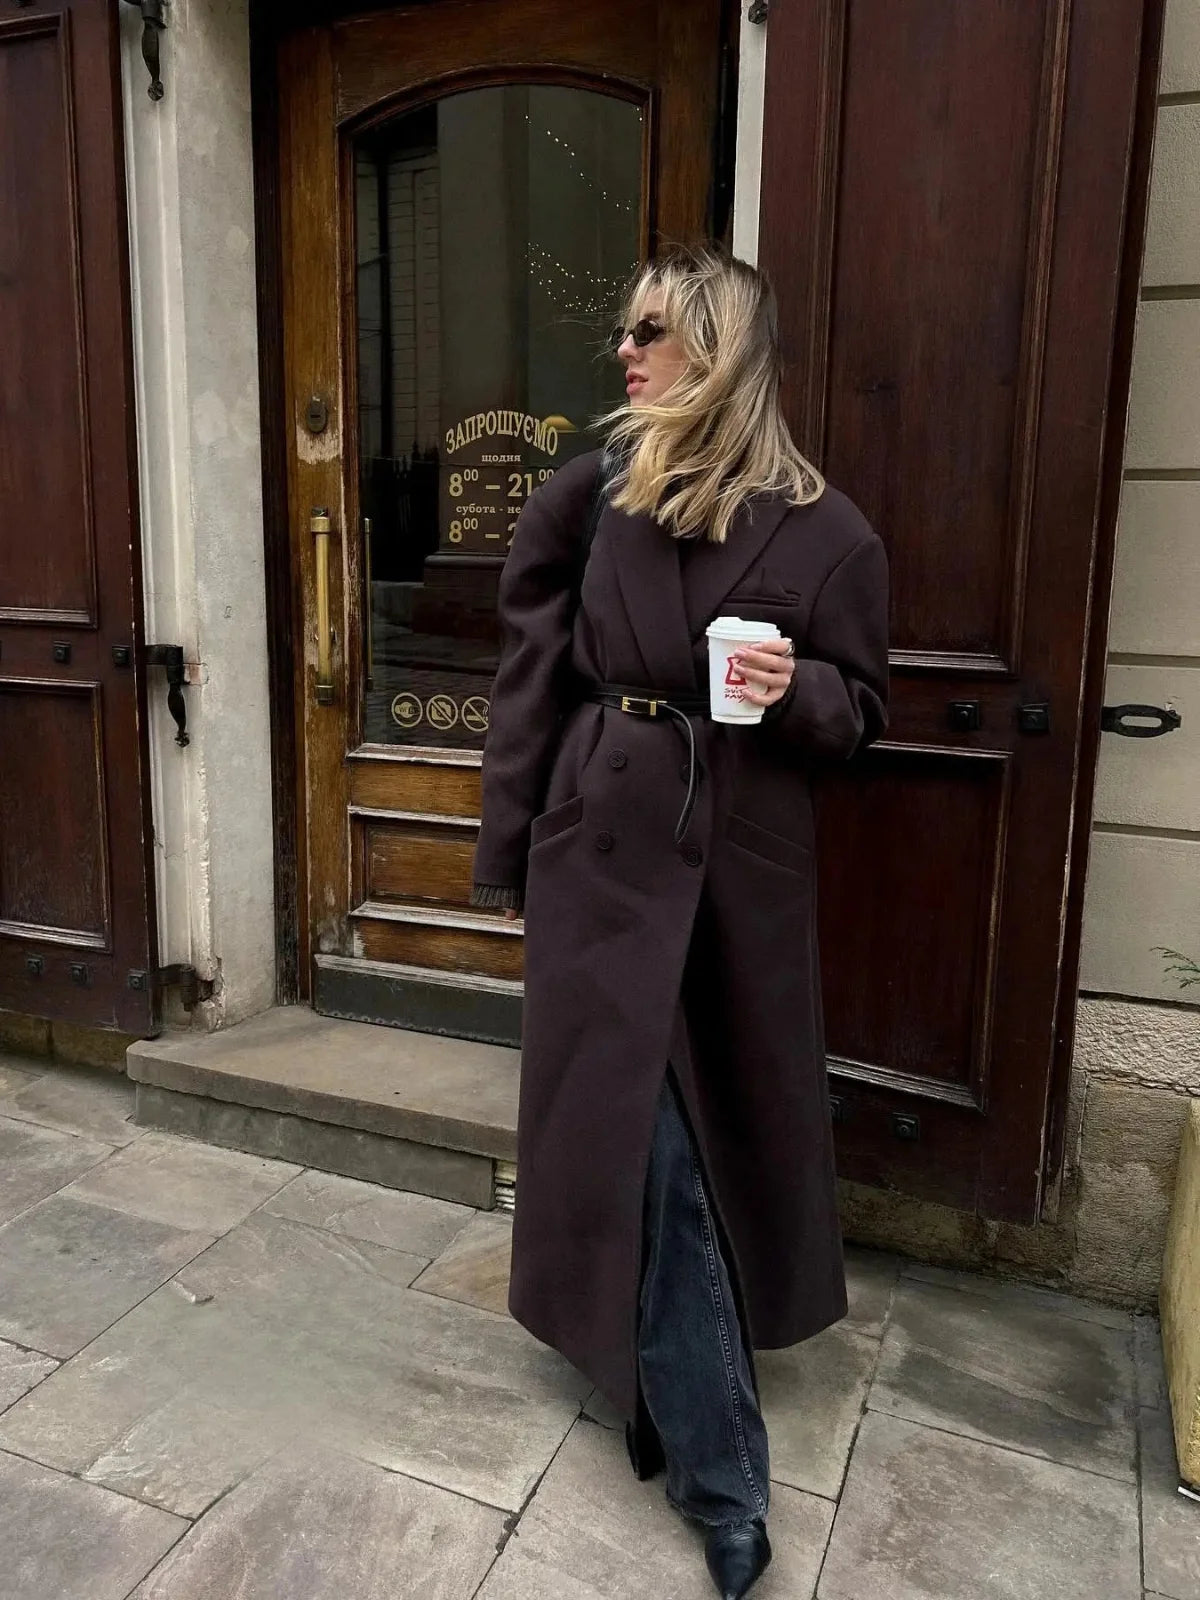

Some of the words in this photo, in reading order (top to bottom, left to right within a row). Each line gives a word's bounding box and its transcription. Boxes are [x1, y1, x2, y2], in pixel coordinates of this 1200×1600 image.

[446, 410, 558, 456] ЗАПРОШУЄМО
[481, 454, 521, 463] щодня
[456, 503, 496, 515] субота
